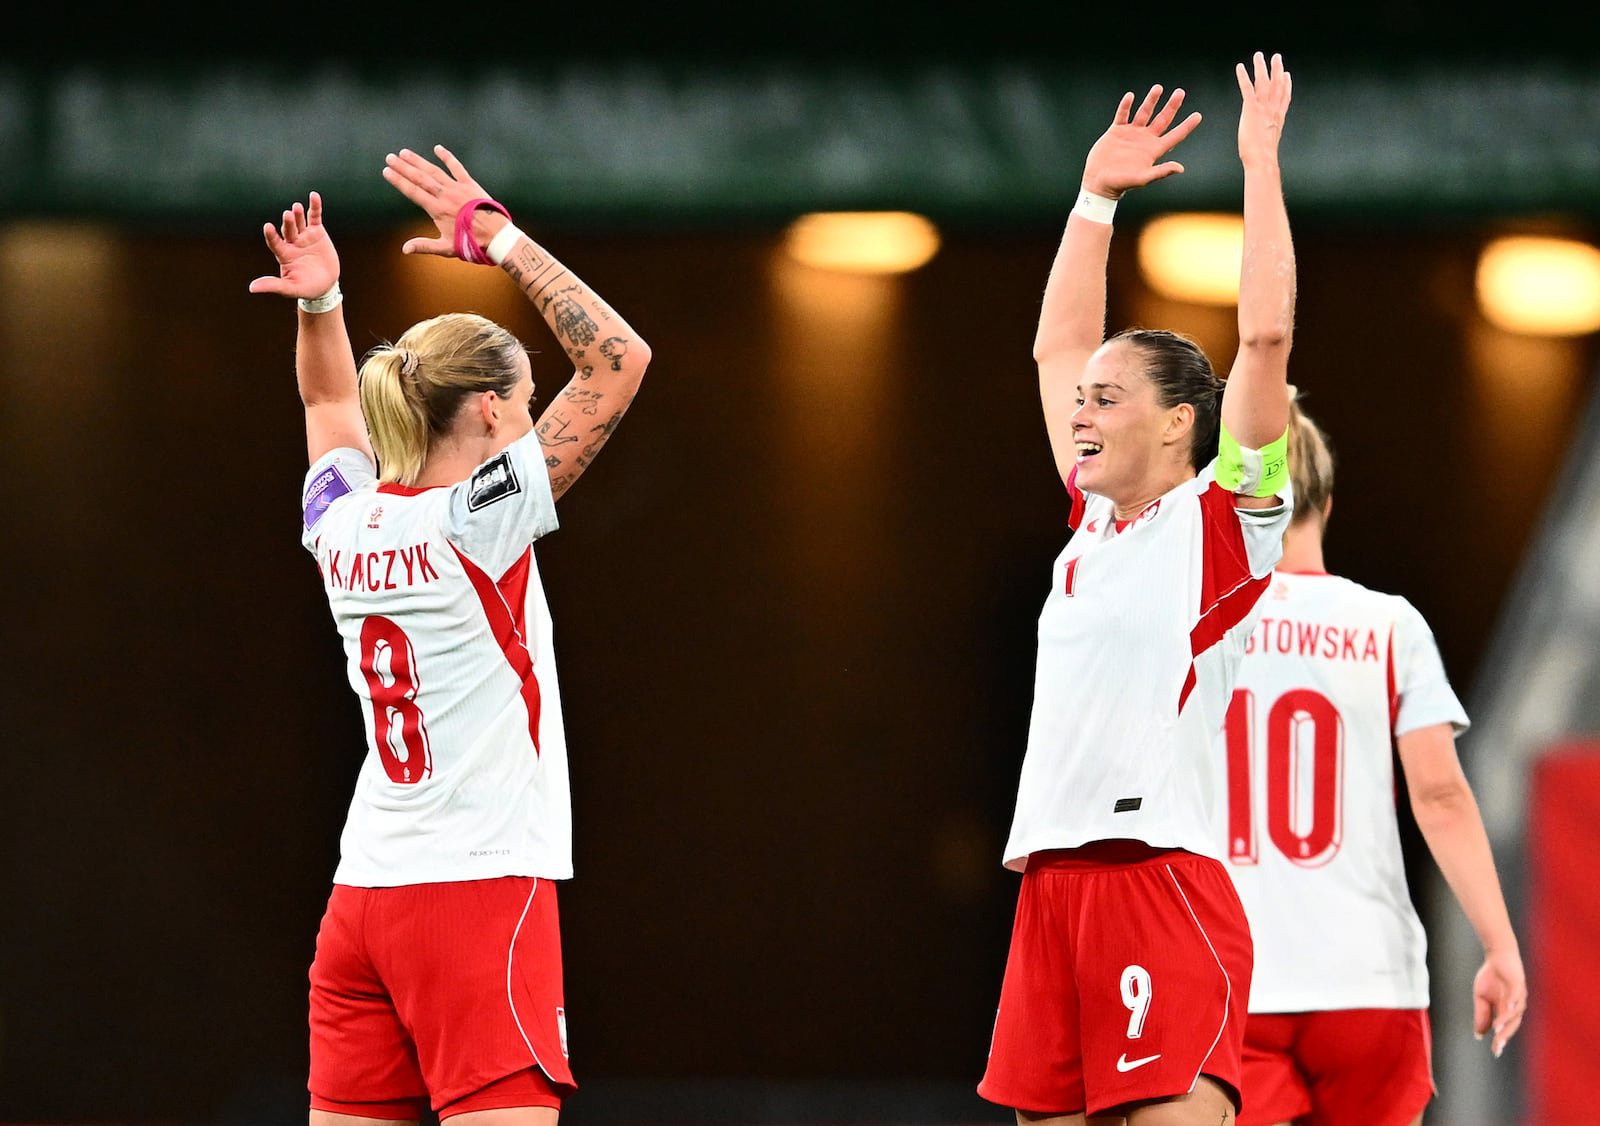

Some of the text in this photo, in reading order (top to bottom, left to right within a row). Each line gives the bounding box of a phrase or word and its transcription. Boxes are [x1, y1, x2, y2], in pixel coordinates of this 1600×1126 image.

[329, 542, 439, 592] KMCZYK
[359, 614, 433, 784] 8
[1223, 688, 1345, 868] 10
[1120, 964, 1152, 1039] 9
